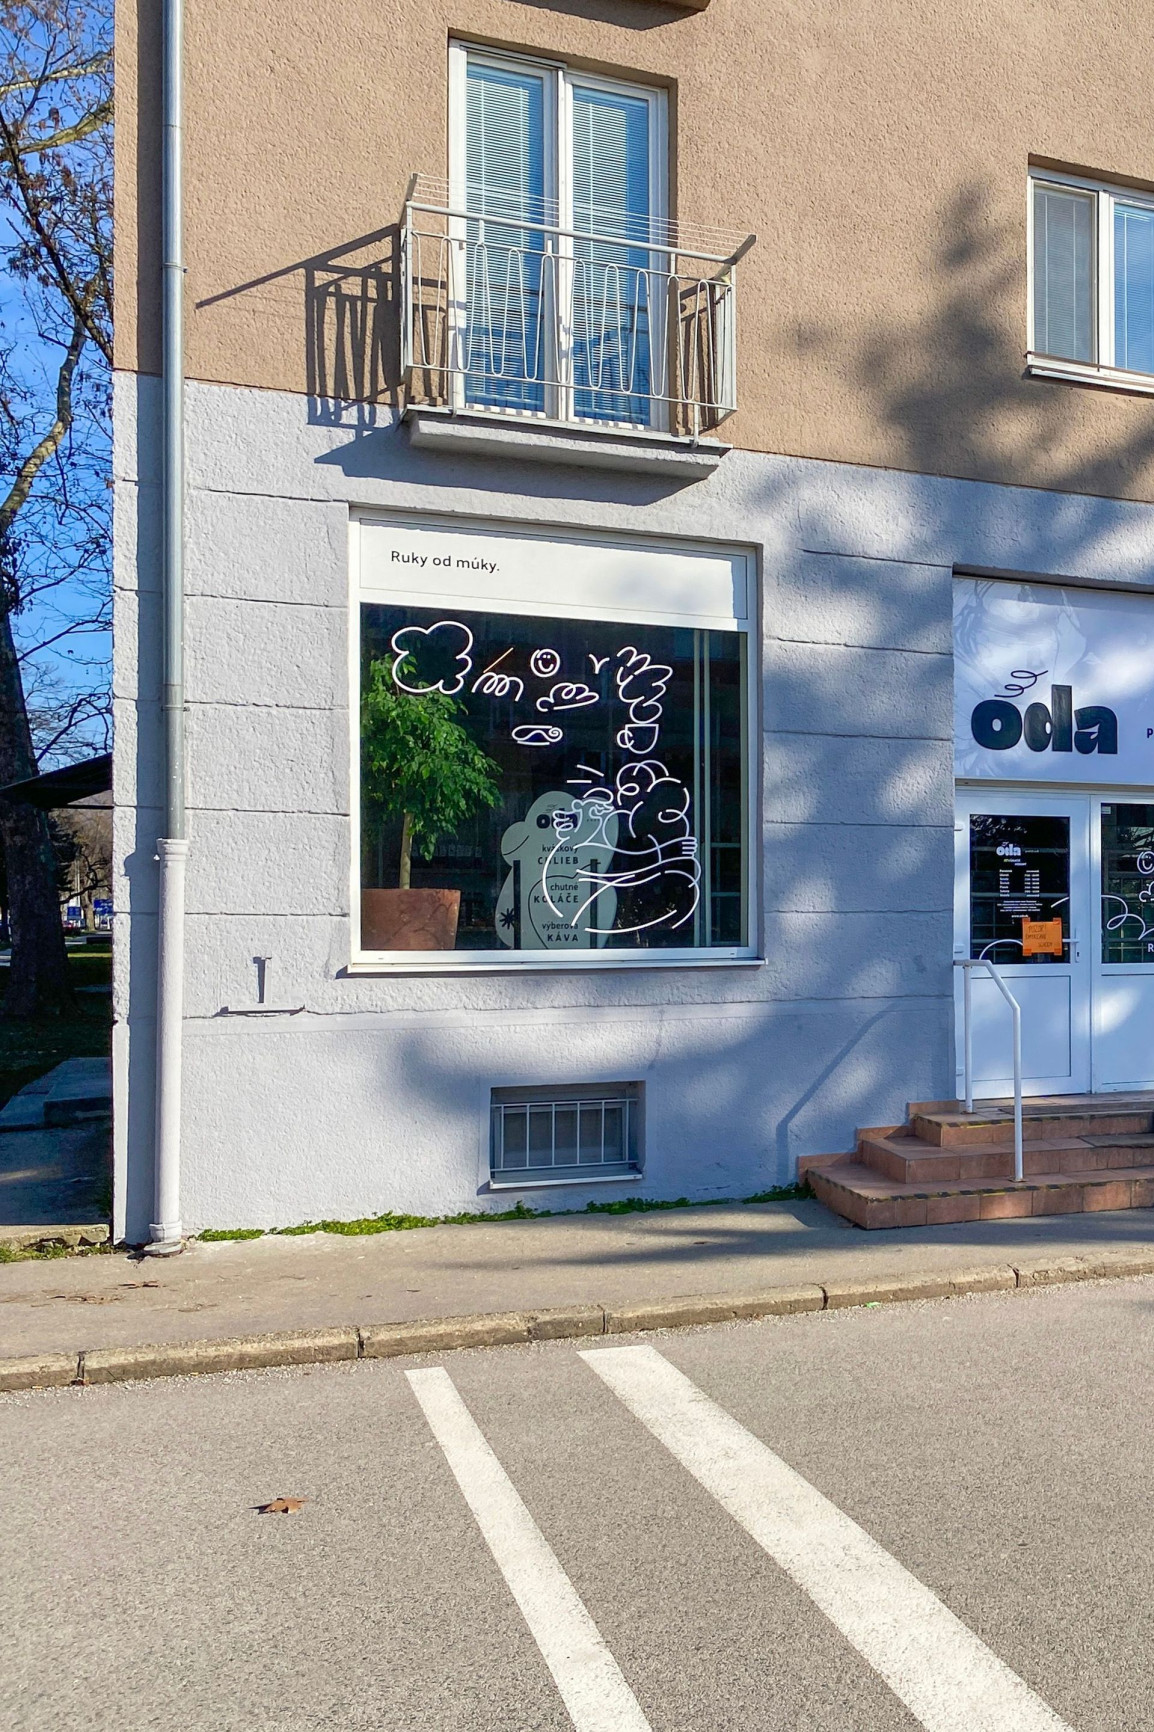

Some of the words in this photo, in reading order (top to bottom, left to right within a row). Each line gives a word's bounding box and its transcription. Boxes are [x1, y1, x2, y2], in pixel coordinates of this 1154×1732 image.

[391, 550, 428, 567] Ruky
[432, 555, 452, 567] od
[456, 557, 500, 573] múky.
[550, 882, 579, 891] chutné
[547, 931, 579, 942] KÁVA
